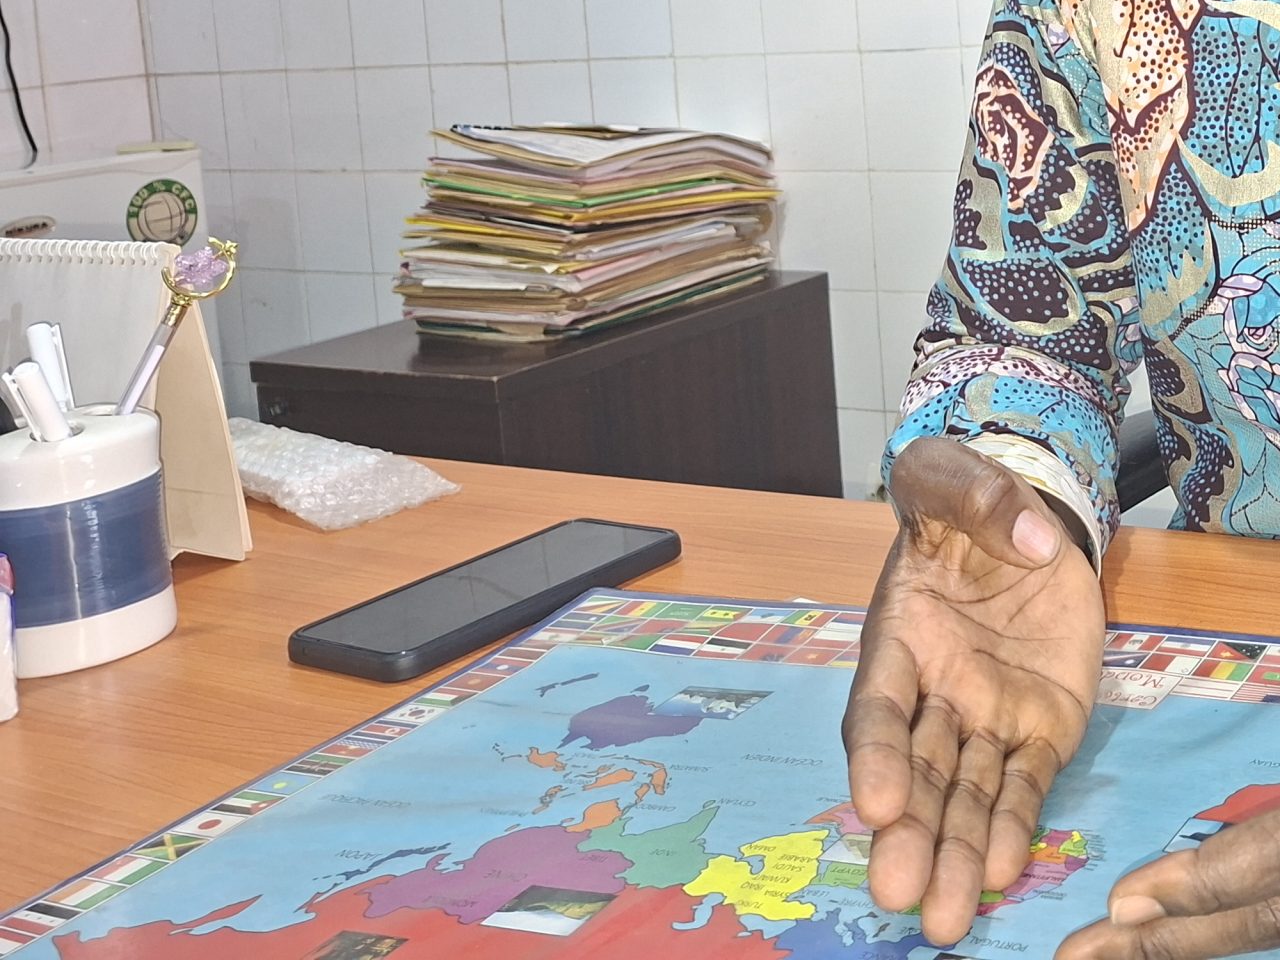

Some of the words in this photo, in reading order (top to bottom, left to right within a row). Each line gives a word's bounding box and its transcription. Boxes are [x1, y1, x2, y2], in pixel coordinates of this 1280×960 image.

[129, 187, 149, 215] 100
[1099, 670, 1165, 689] Mond
[716, 798, 757, 808] CEYLAN
[745, 844, 777, 853] OMAN
[777, 853, 814, 863] ARABIE
[772, 862, 806, 872] SAUDI
[830, 866, 867, 876] EGYPT
[970, 935, 1029, 953] PORTUGAL
